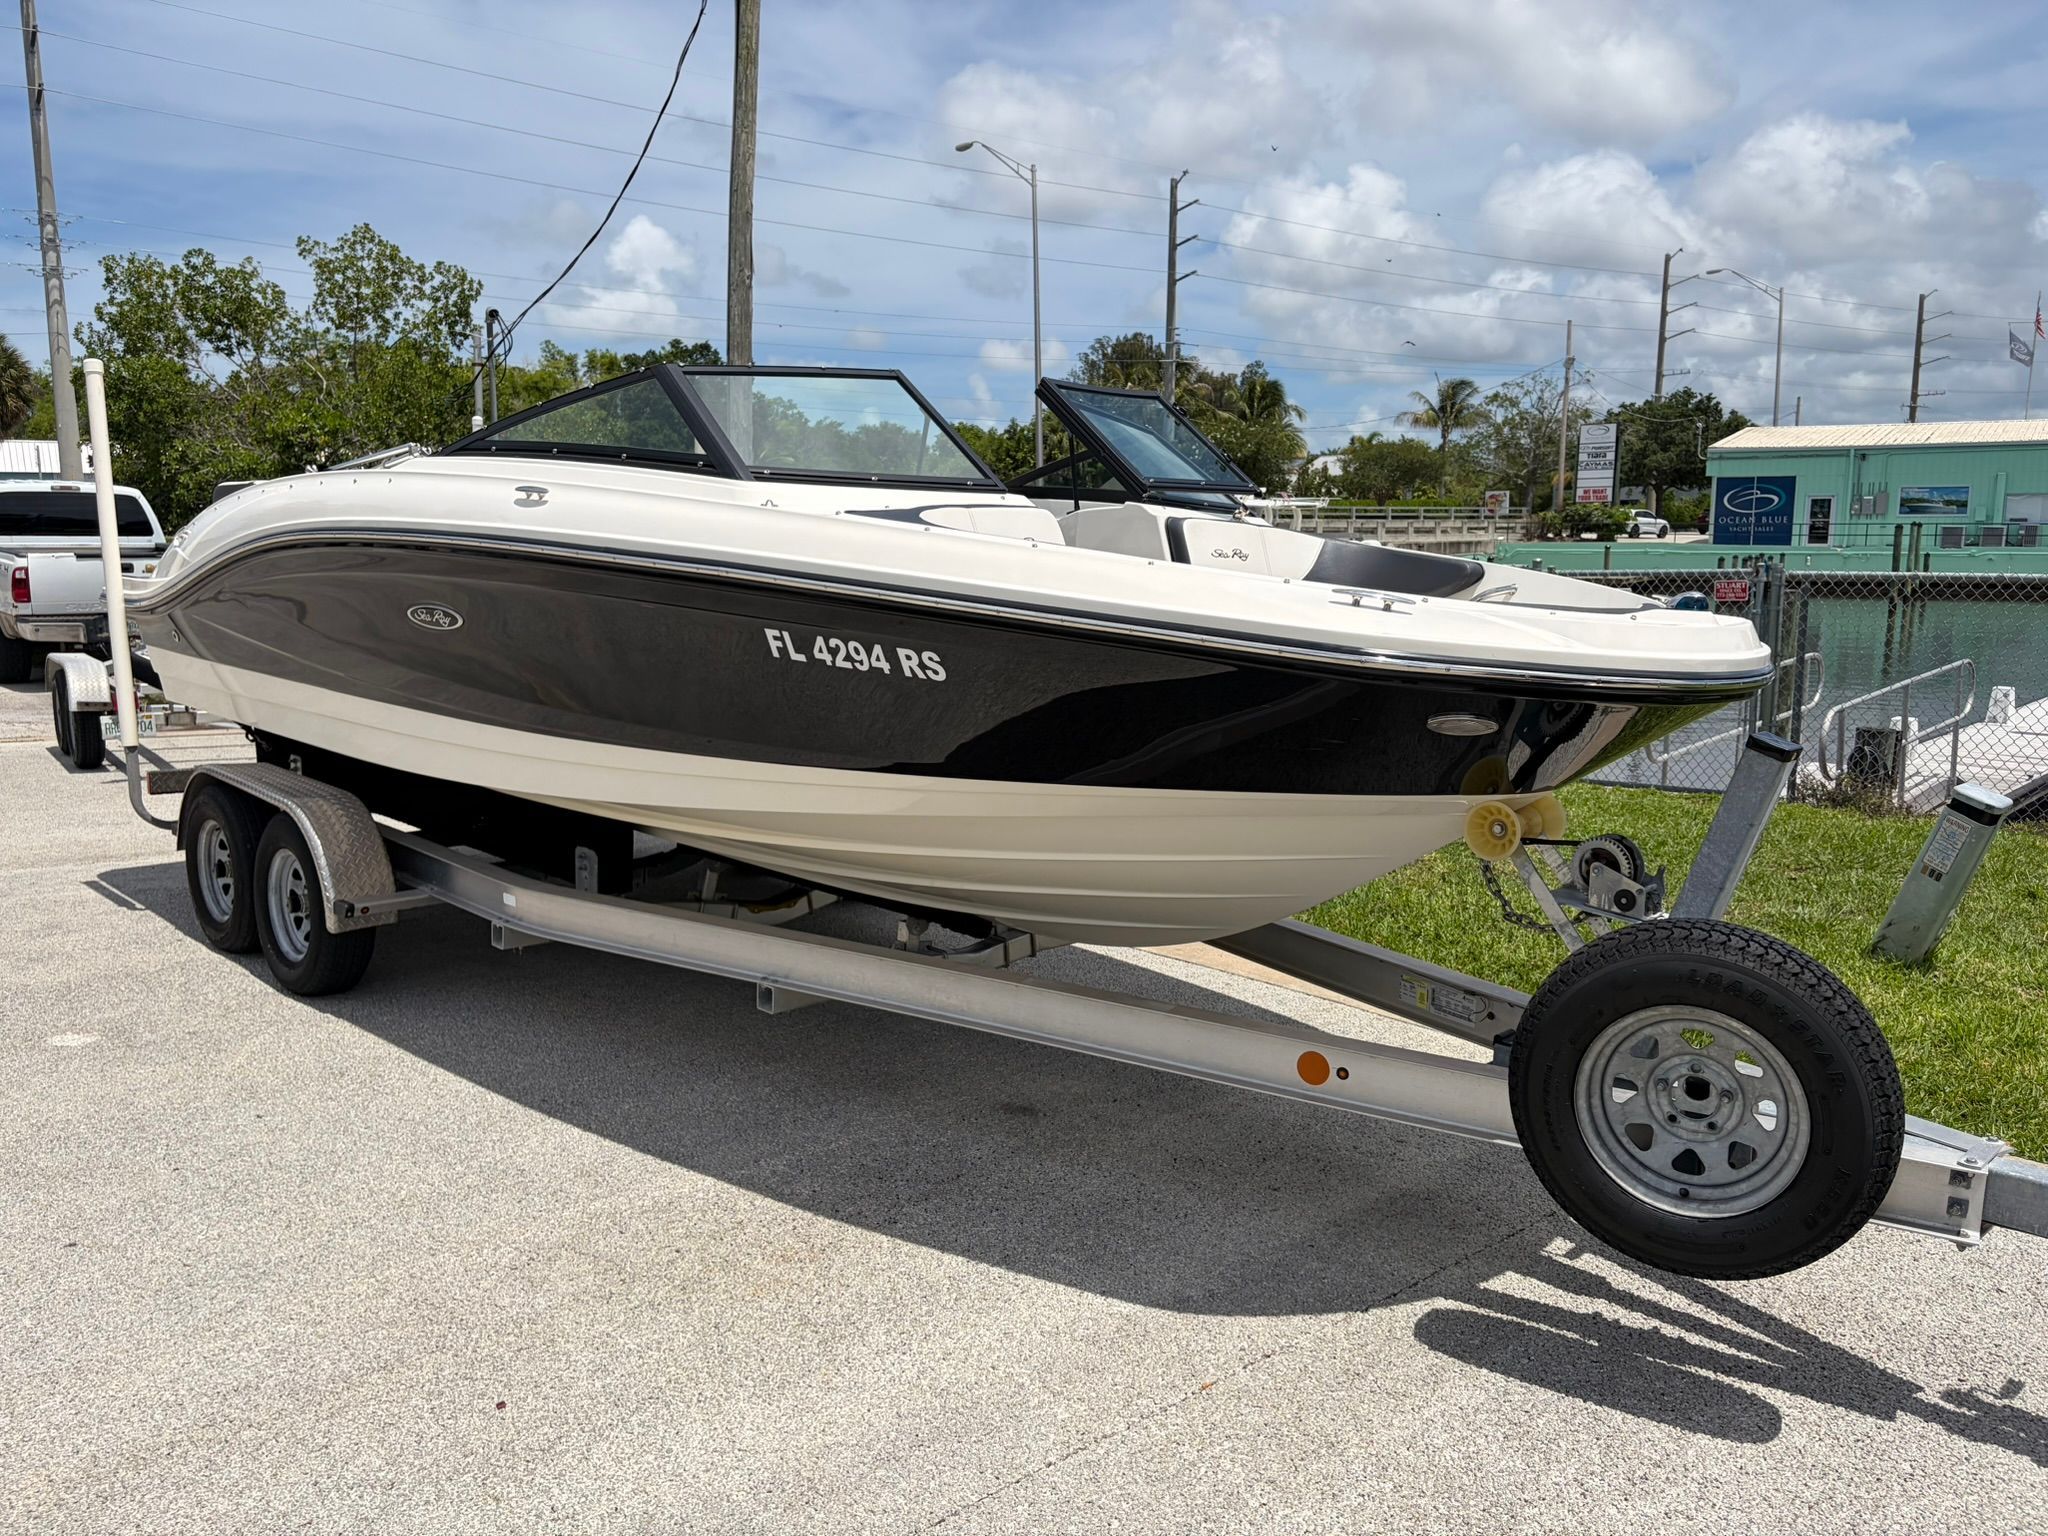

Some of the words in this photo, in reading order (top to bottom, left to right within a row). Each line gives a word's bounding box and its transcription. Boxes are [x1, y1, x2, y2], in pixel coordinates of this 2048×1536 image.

[1718, 516, 1756, 524] OCEAN
[1762, 516, 1788, 524] BLUE
[1211, 548, 1230, 558] Sea
[1232, 548, 1249, 561] Ray
[414, 608, 432, 621] Sea
[432, 610, 451, 627] Ray
[764, 628, 807, 662] FL
[812, 636, 891, 674] 4294
[896, 647, 947, 682] RS
[1946, 818, 1970, 833] WARNING
